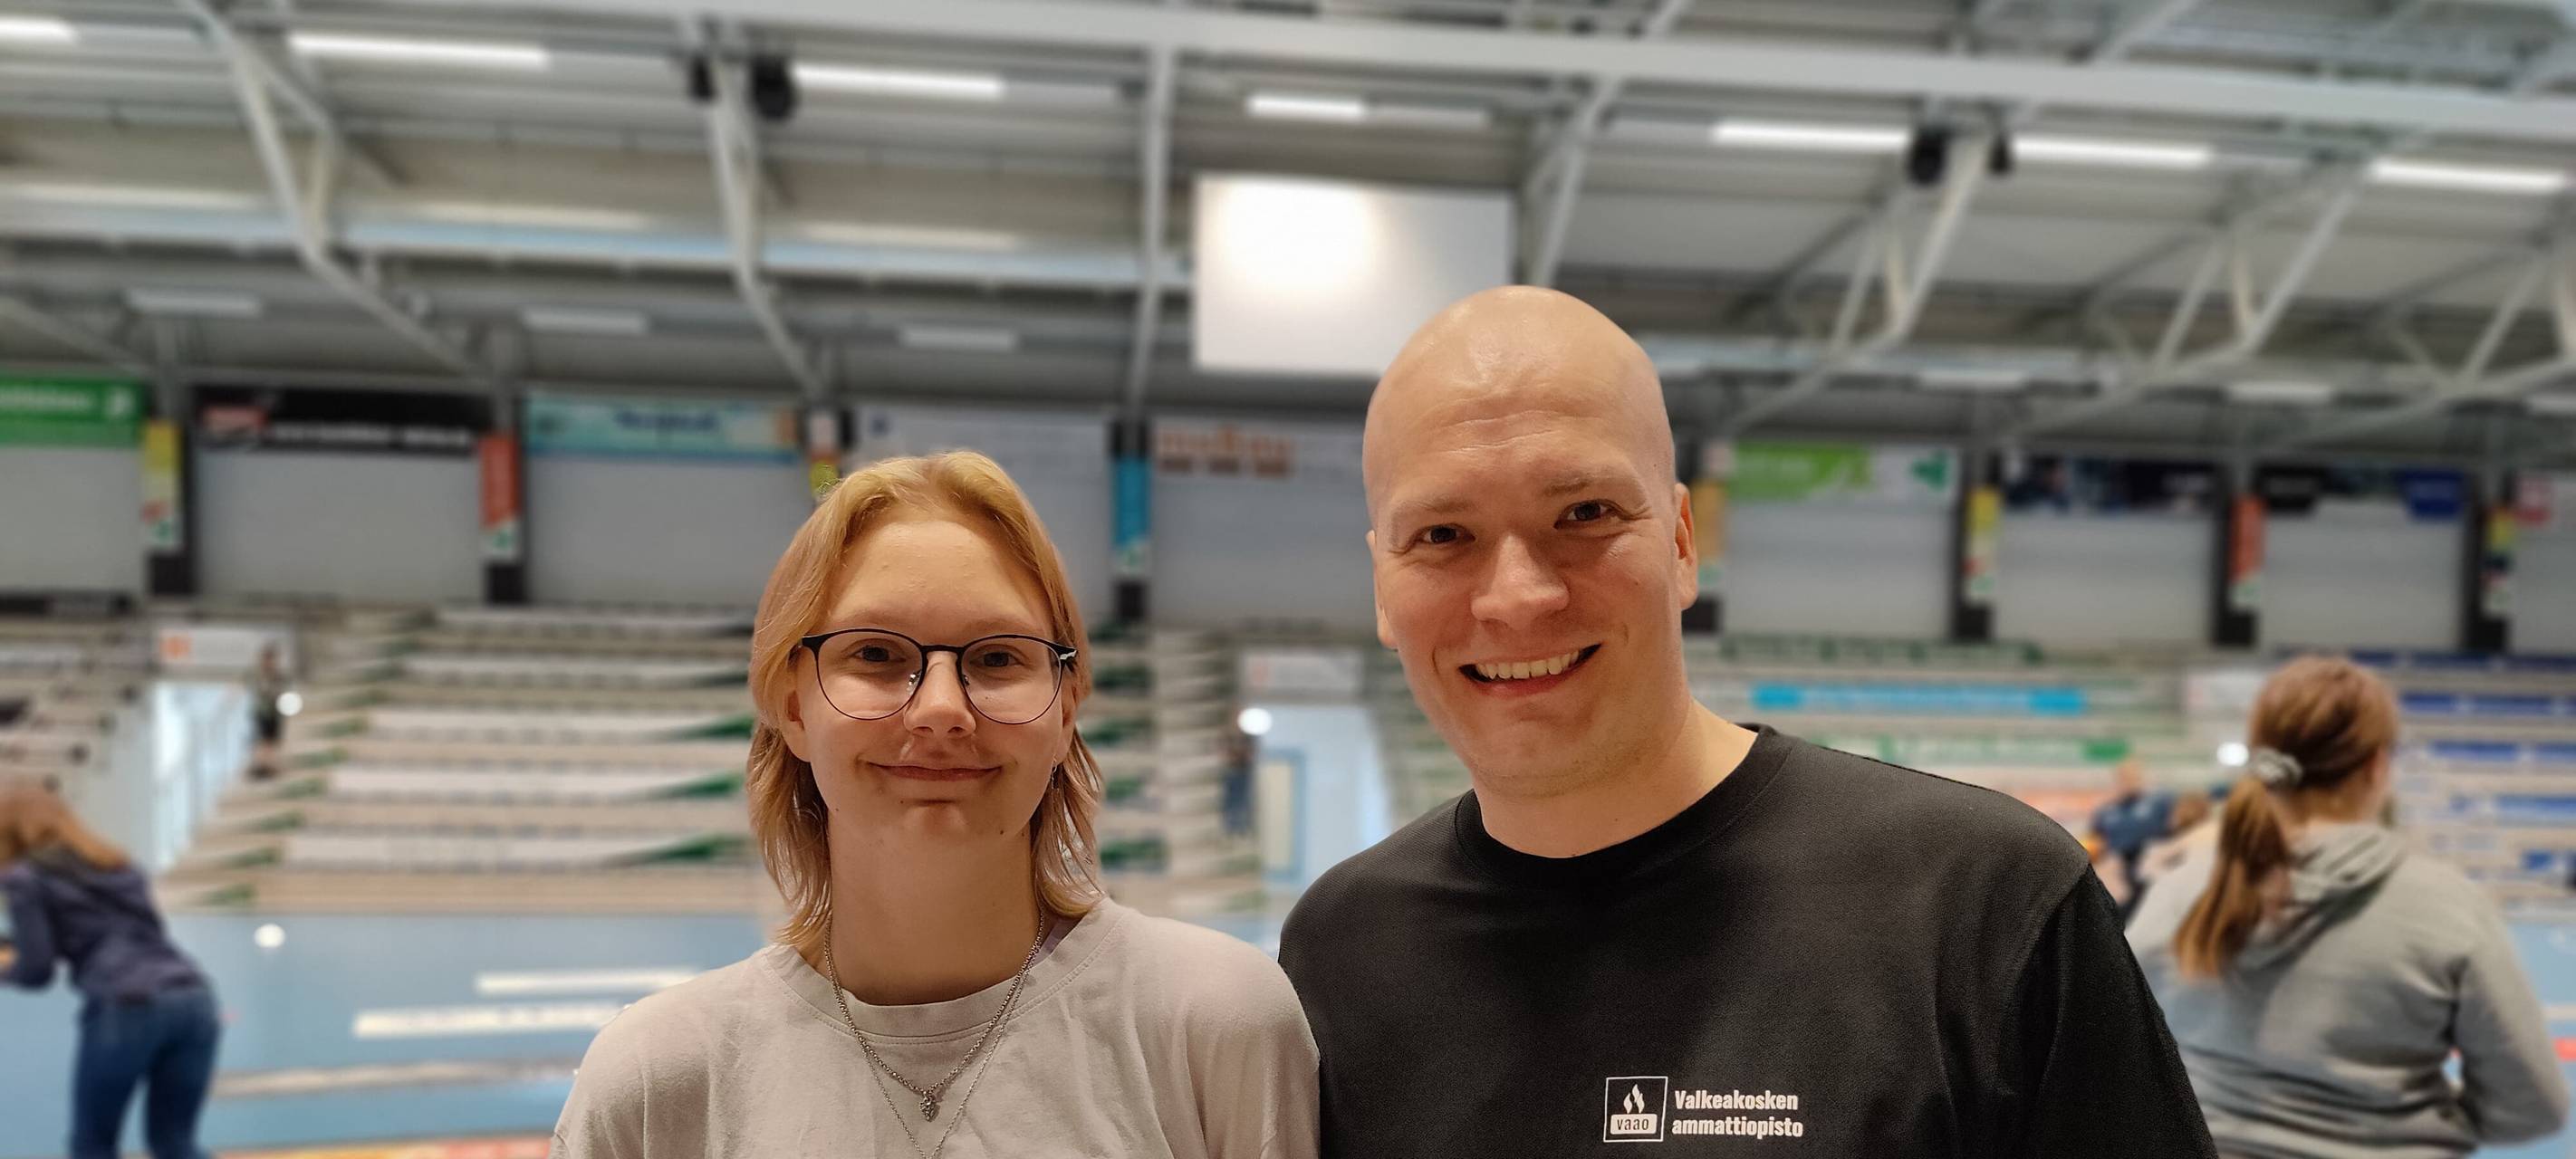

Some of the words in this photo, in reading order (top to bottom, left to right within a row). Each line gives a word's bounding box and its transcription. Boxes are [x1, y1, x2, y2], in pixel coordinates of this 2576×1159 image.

[1675, 1090, 1799, 1110] Valkeakosken
[1616, 1117, 1650, 1132] vaao
[1672, 1116, 1803, 1140] ammattiopisto
